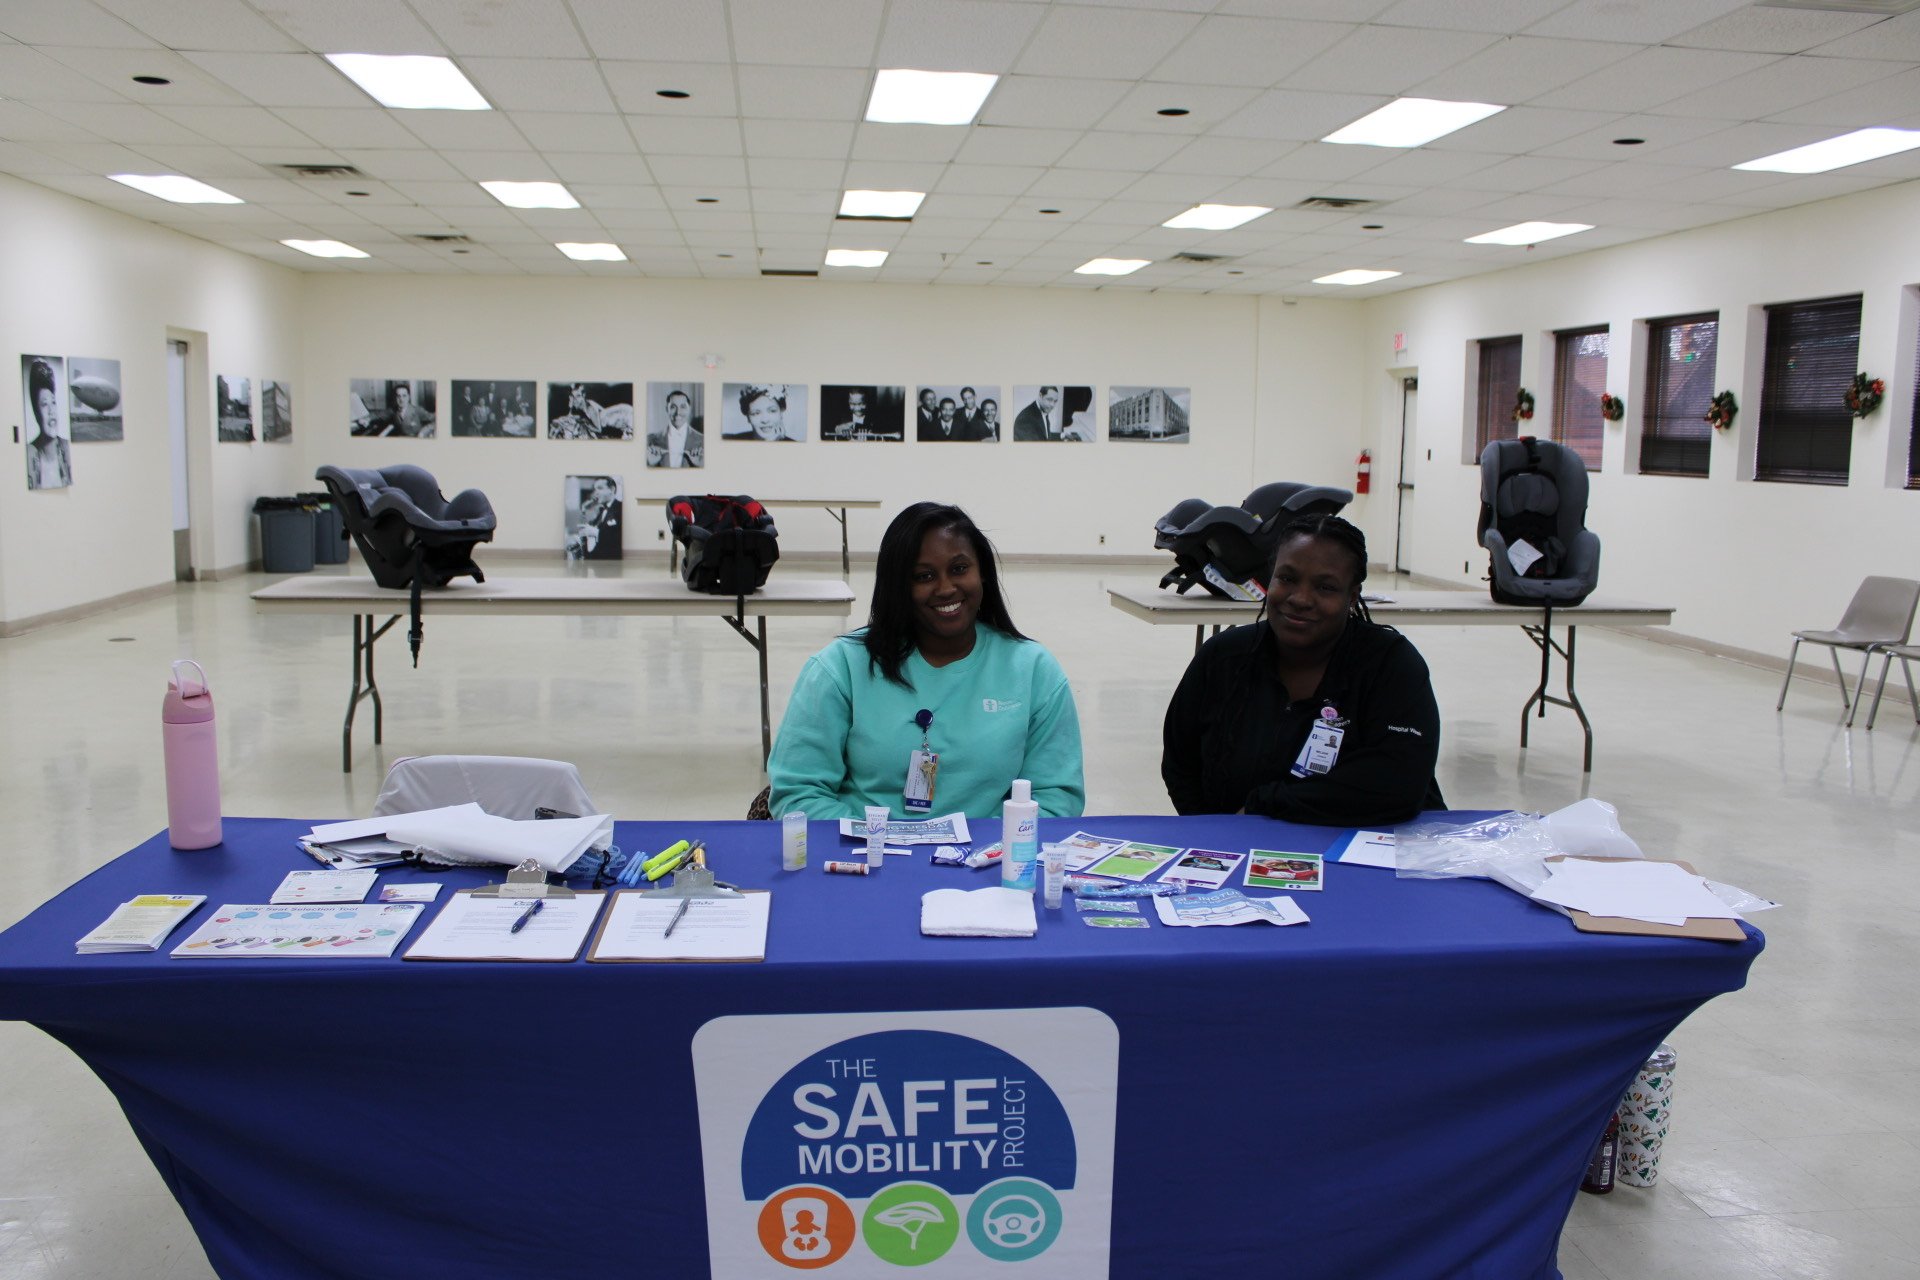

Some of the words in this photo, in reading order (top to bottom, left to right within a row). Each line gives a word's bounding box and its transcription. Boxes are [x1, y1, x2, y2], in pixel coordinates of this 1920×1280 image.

[1388, 725, 1408, 733] Hospital
[825, 1058, 877, 1079] THE
[792, 1078, 999, 1140] SAFE
[1002, 1076, 1027, 1168] PROJECT
[798, 1139, 998, 1175] MOBILITY
